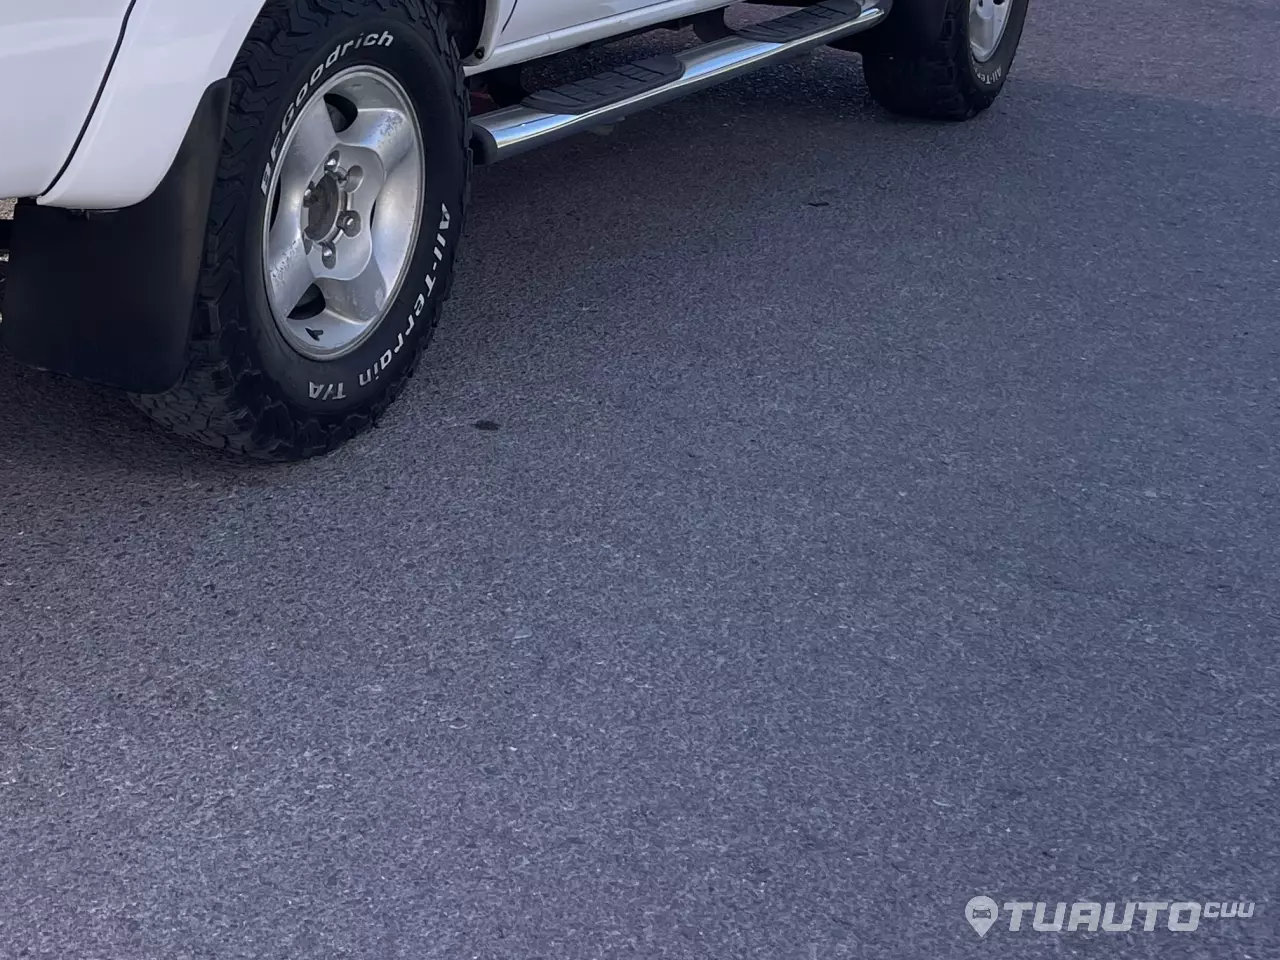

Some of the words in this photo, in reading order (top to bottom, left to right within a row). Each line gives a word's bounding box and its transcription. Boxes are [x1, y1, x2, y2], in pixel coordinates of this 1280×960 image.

[260, 30, 394, 196] BFGoodrich
[358, 202, 451, 387] All-Terrain
[308, 381, 347, 401] T/A
